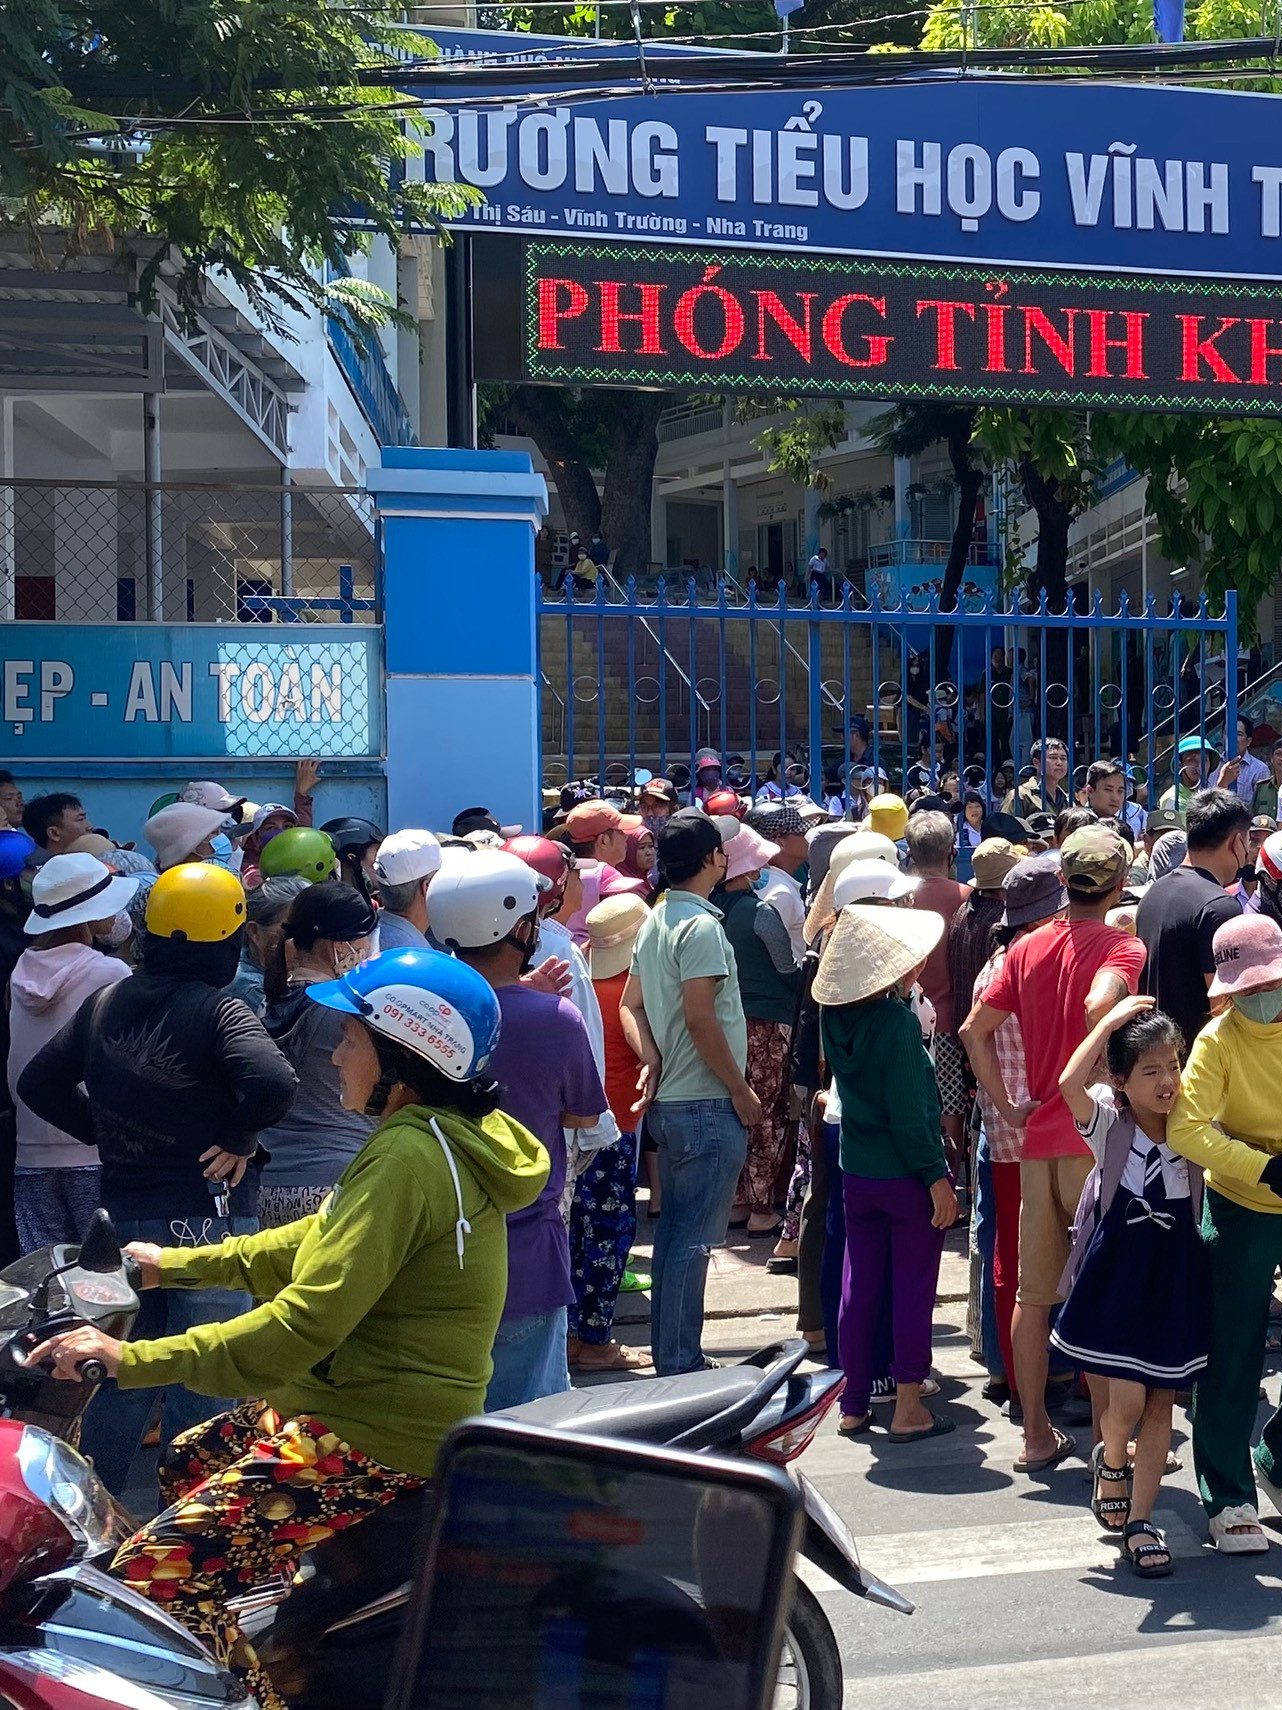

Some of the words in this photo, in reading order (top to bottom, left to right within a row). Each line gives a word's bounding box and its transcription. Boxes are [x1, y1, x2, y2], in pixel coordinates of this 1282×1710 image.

[384, 98, 680, 198] RƯỜNG
[705, 100, 871, 211] TIỂU
[895, 139, 1042, 232] HỌC
[1065, 141, 1230, 235] VĨNH
[470, 202, 501, 226] Thị
[506, 204, 546, 224] Sáu
[564, 207, 609, 228] Vĩnh
[615, 211, 687, 234] Trường
[706, 217, 747, 236] Nha
[752, 220, 809, 241] Trang
[537, 265, 895, 369] PHÓNG
[915, 281, 1151, 379] TỈNH
[123, 661, 194, 722] AN
[208, 644, 343, 723] TOÀN
[383, 1004, 404, 1021] 091
[404, 1018, 428, 1037] 333
[427, 1034, 456, 1058] 6555
[1101, 1469, 1125, 1479] RGXX
[1100, 1500, 1128, 1511] RGXX
